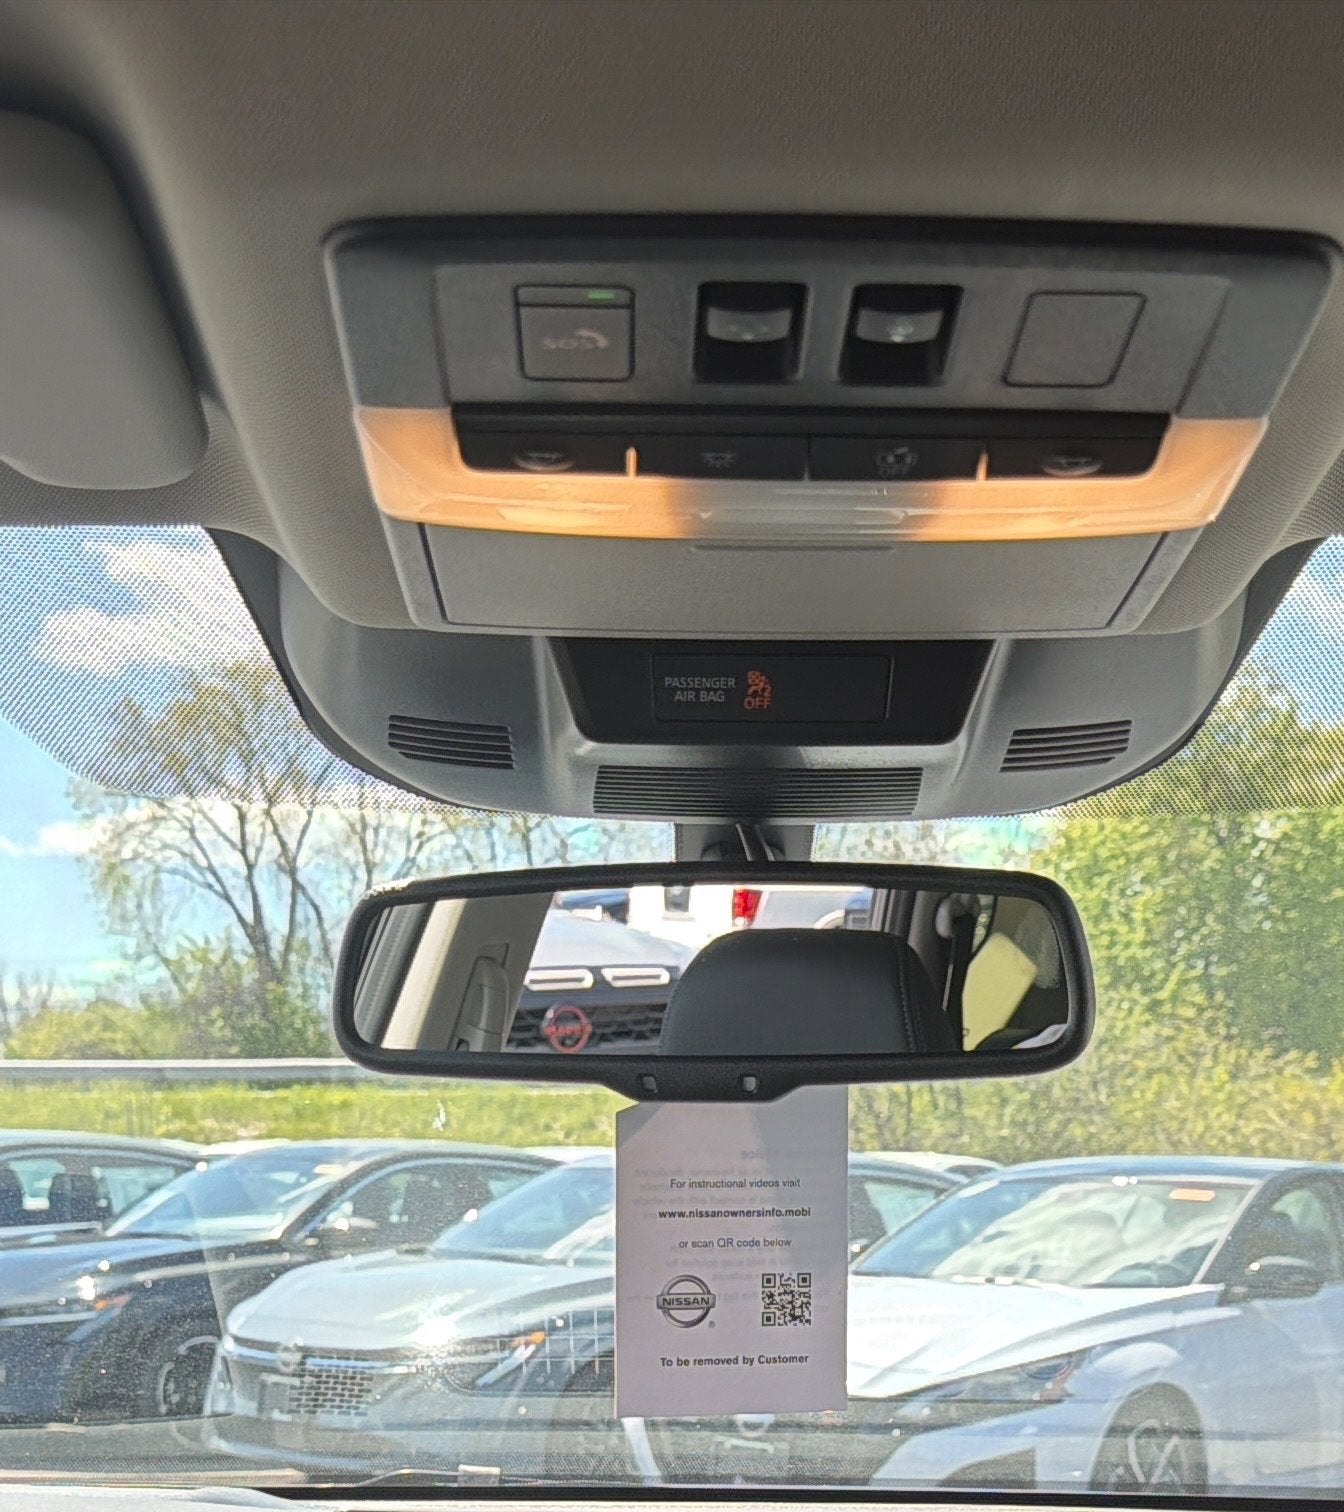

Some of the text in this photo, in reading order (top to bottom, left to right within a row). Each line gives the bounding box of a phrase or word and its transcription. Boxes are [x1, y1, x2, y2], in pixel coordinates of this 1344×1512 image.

[664, 677, 736, 688] PASSENGER
[674, 691, 725, 702] AIR BAG
[744, 697, 771, 710] OFF
[670, 1178, 800, 1189] For instructional videos visit
[658, 1208, 811, 1219] www.nissanownersinfo.mobi
[678, 1238, 792, 1248] or scan QR code below
[662, 1297, 711, 1306] NISSAN
[660, 1354, 808, 1368] To be removed by Customer
